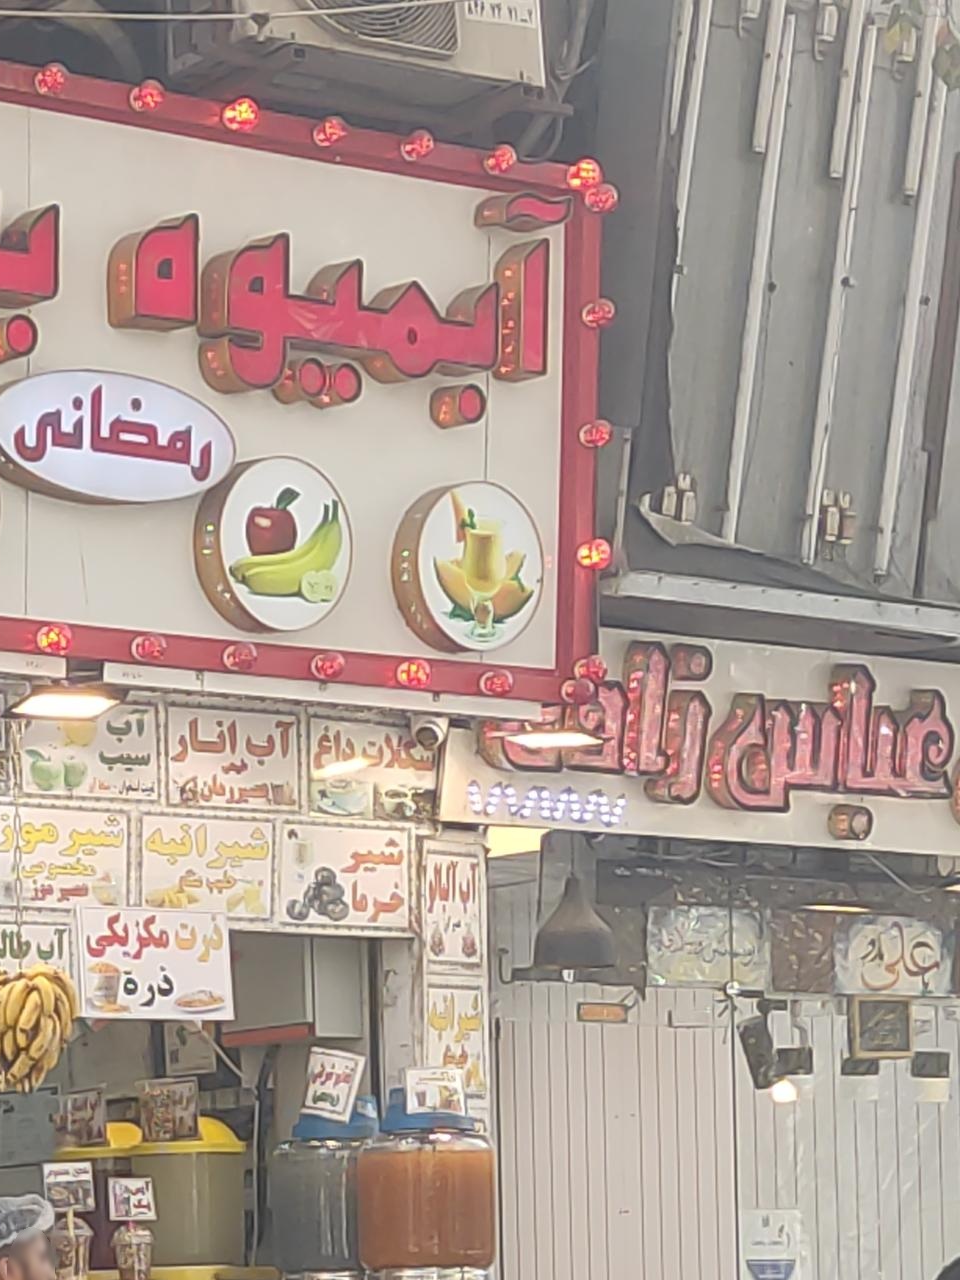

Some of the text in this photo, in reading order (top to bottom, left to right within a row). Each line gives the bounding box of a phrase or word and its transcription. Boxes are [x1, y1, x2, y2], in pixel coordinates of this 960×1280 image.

[108, 193, 571, 428] آبمیوه
[14, 384, 212, 482] رمضانی
[106, 708, 149, 743] آب
[170, 717, 294, 765] آب انار
[98, 750, 151, 772] سیب
[59, 814, 124, 857] شیر
[145, 823, 269, 869] شیر انبه
[340, 837, 404, 873] شیر
[351, 880, 405, 923] خرما
[36, 927, 68, 965] آب
[86, 912, 224, 963] ذرت مکزیکی
